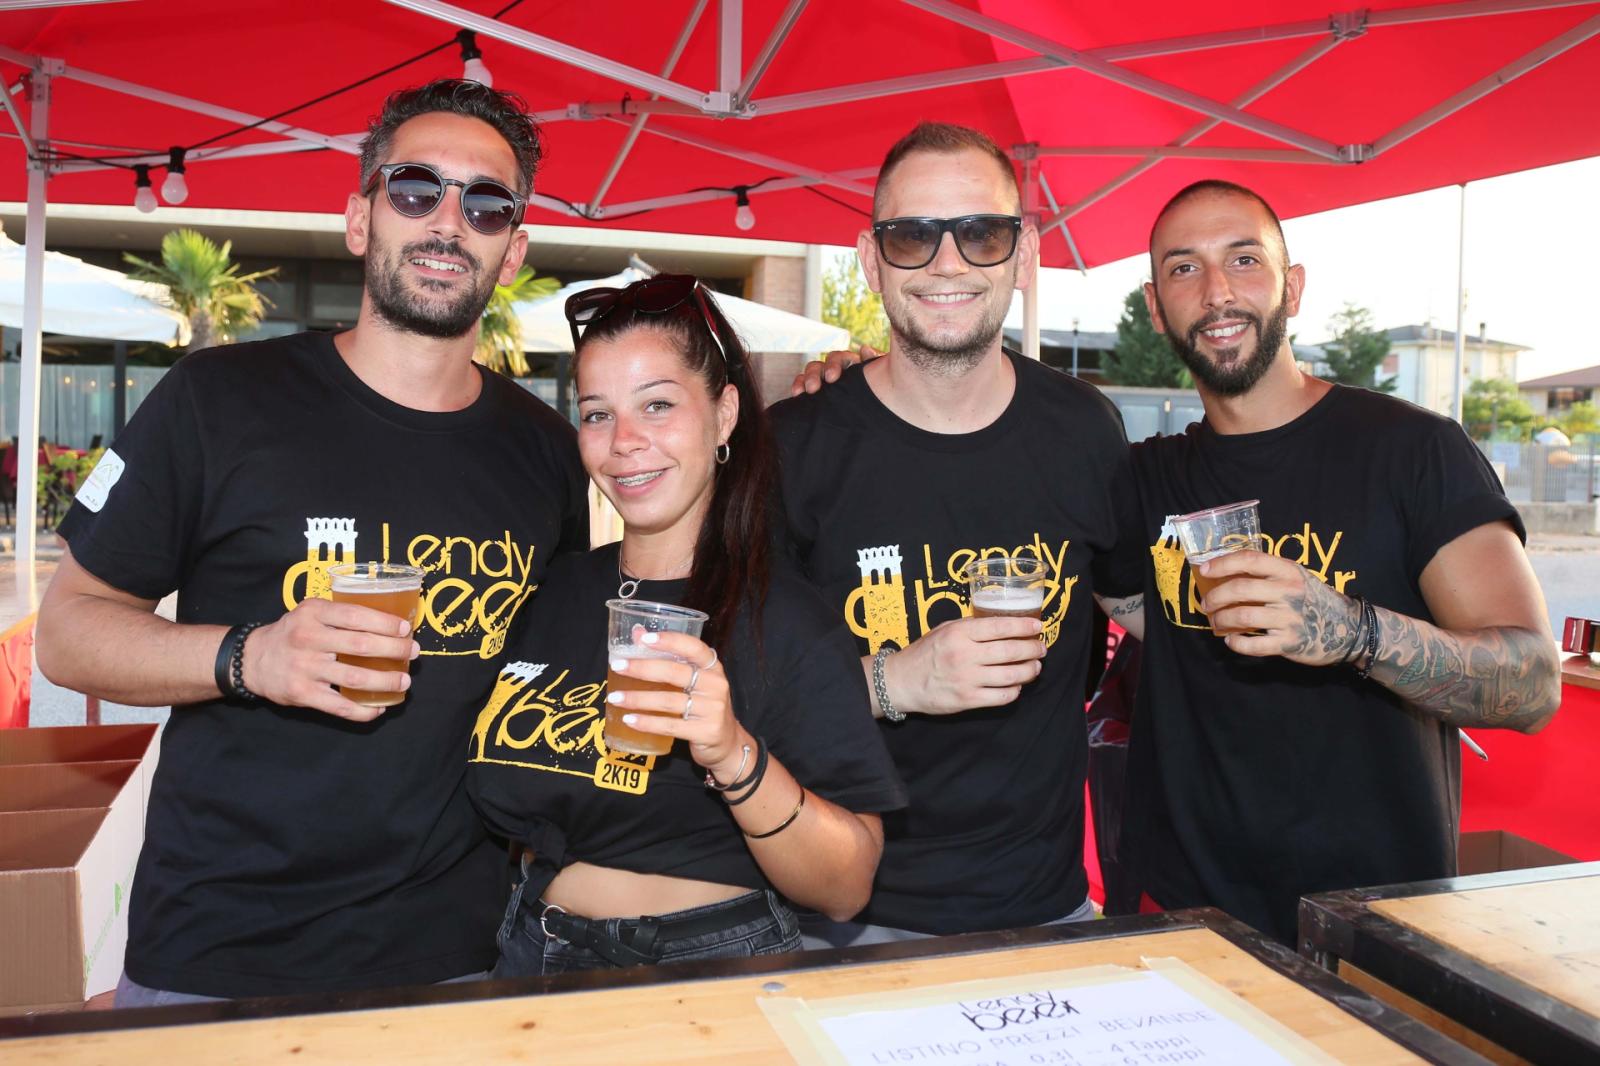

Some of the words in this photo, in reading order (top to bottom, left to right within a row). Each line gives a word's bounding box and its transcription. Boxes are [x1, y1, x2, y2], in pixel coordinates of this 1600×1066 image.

[601, 763, 641, 789] 2K19
[871, 1040, 982, 1064] LISTINO
[988, 1025, 1082, 1049] PREZZI
[1098, 1010, 1216, 1032] BEVANDE
[1127, 1034, 1192, 1052] Tappi
[1140, 1046, 1207, 1066] Tappi
